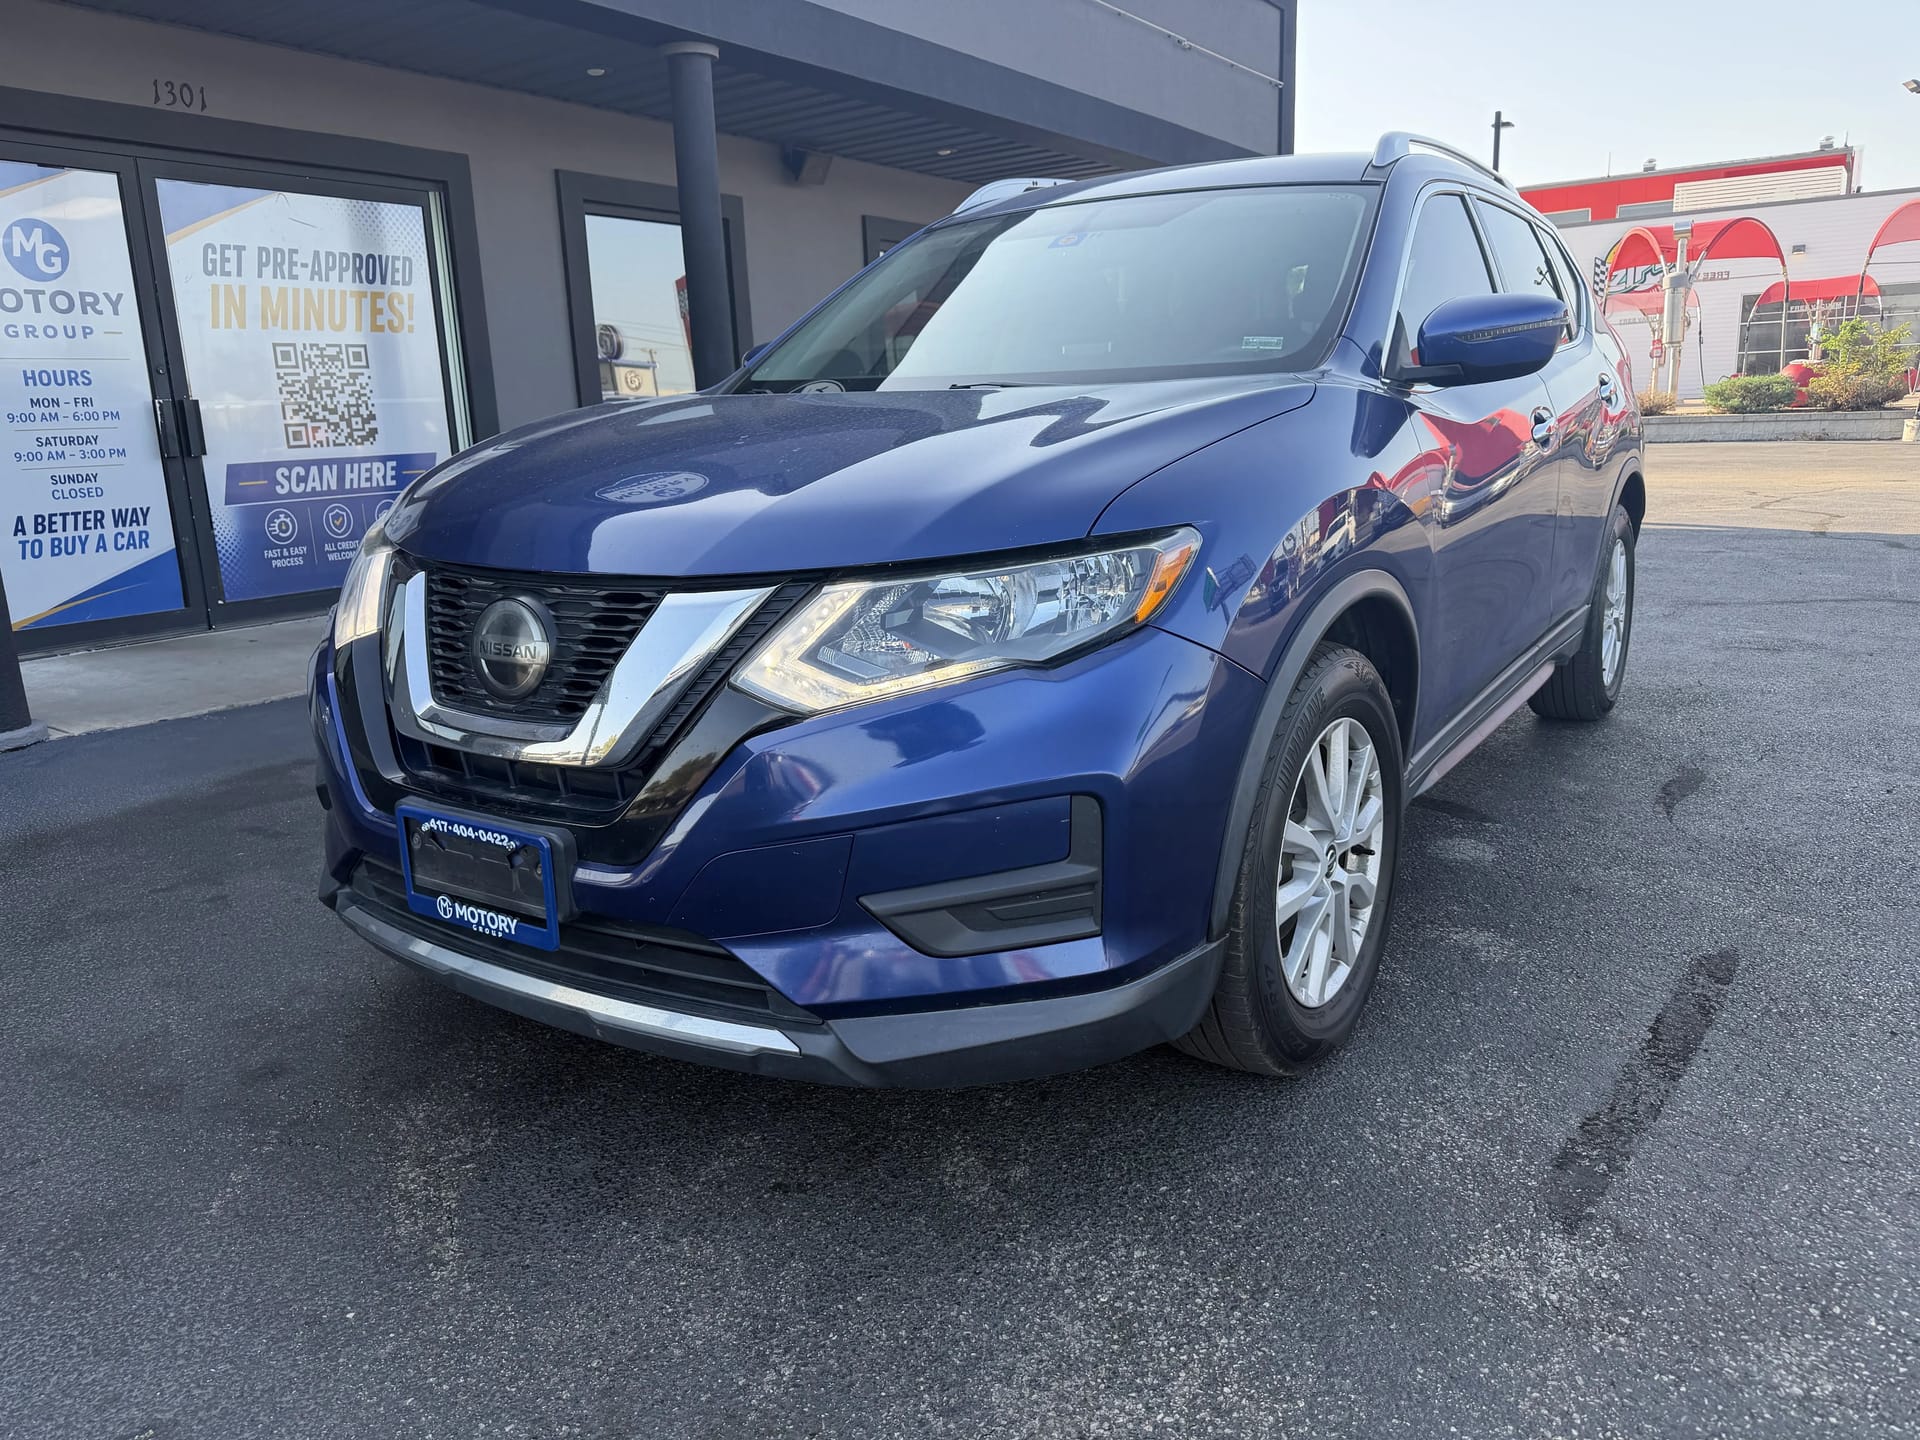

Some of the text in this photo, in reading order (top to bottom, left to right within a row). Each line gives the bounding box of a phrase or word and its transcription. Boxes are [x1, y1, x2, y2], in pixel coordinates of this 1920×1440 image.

[153, 79, 207, 112] 1301
[12, 226, 62, 274] MG
[202, 243, 413, 286] GET PRE-APPROVED
[0, 288, 124, 316] OTORY
[210, 283, 415, 333] IN MINUTES!
[4, 324, 94, 339] GROUP
[22, 369, 93, 387] HOURS
[30, 397, 60, 409] MON
[74, 397, 94, 408] FRI
[7, 412, 36, 423] 9:00
[40, 412, 59, 422] AM
[72, 411, 100, 421] 6:00
[103, 410, 120, 421] PM
[35, 435, 99, 447] SATURDAY
[14, 451, 43, 462] 9:00
[47, 450, 66, 461] AM
[79, 448, 106, 459] 3:00
[109, 448, 127, 458] PM
[50, 473, 98, 485] SUNDAY
[275, 461, 396, 494] SCAN HERE
[51, 486, 104, 500] CLOSED
[13, 506, 151, 536] A BETTER WAY
[18, 530, 150, 560] TO BUY A CAR
[264, 546, 307, 559] FAST & EASY
[325, 540, 359, 552] ALL CREDIT
[272, 557, 304, 568] PROCESS
[328, 551, 356, 561] WELCOM
[480, 640, 537, 659] NISSAN
[455, 902, 519, 935] MOTORY
[473, 924, 503, 937] GROUP
